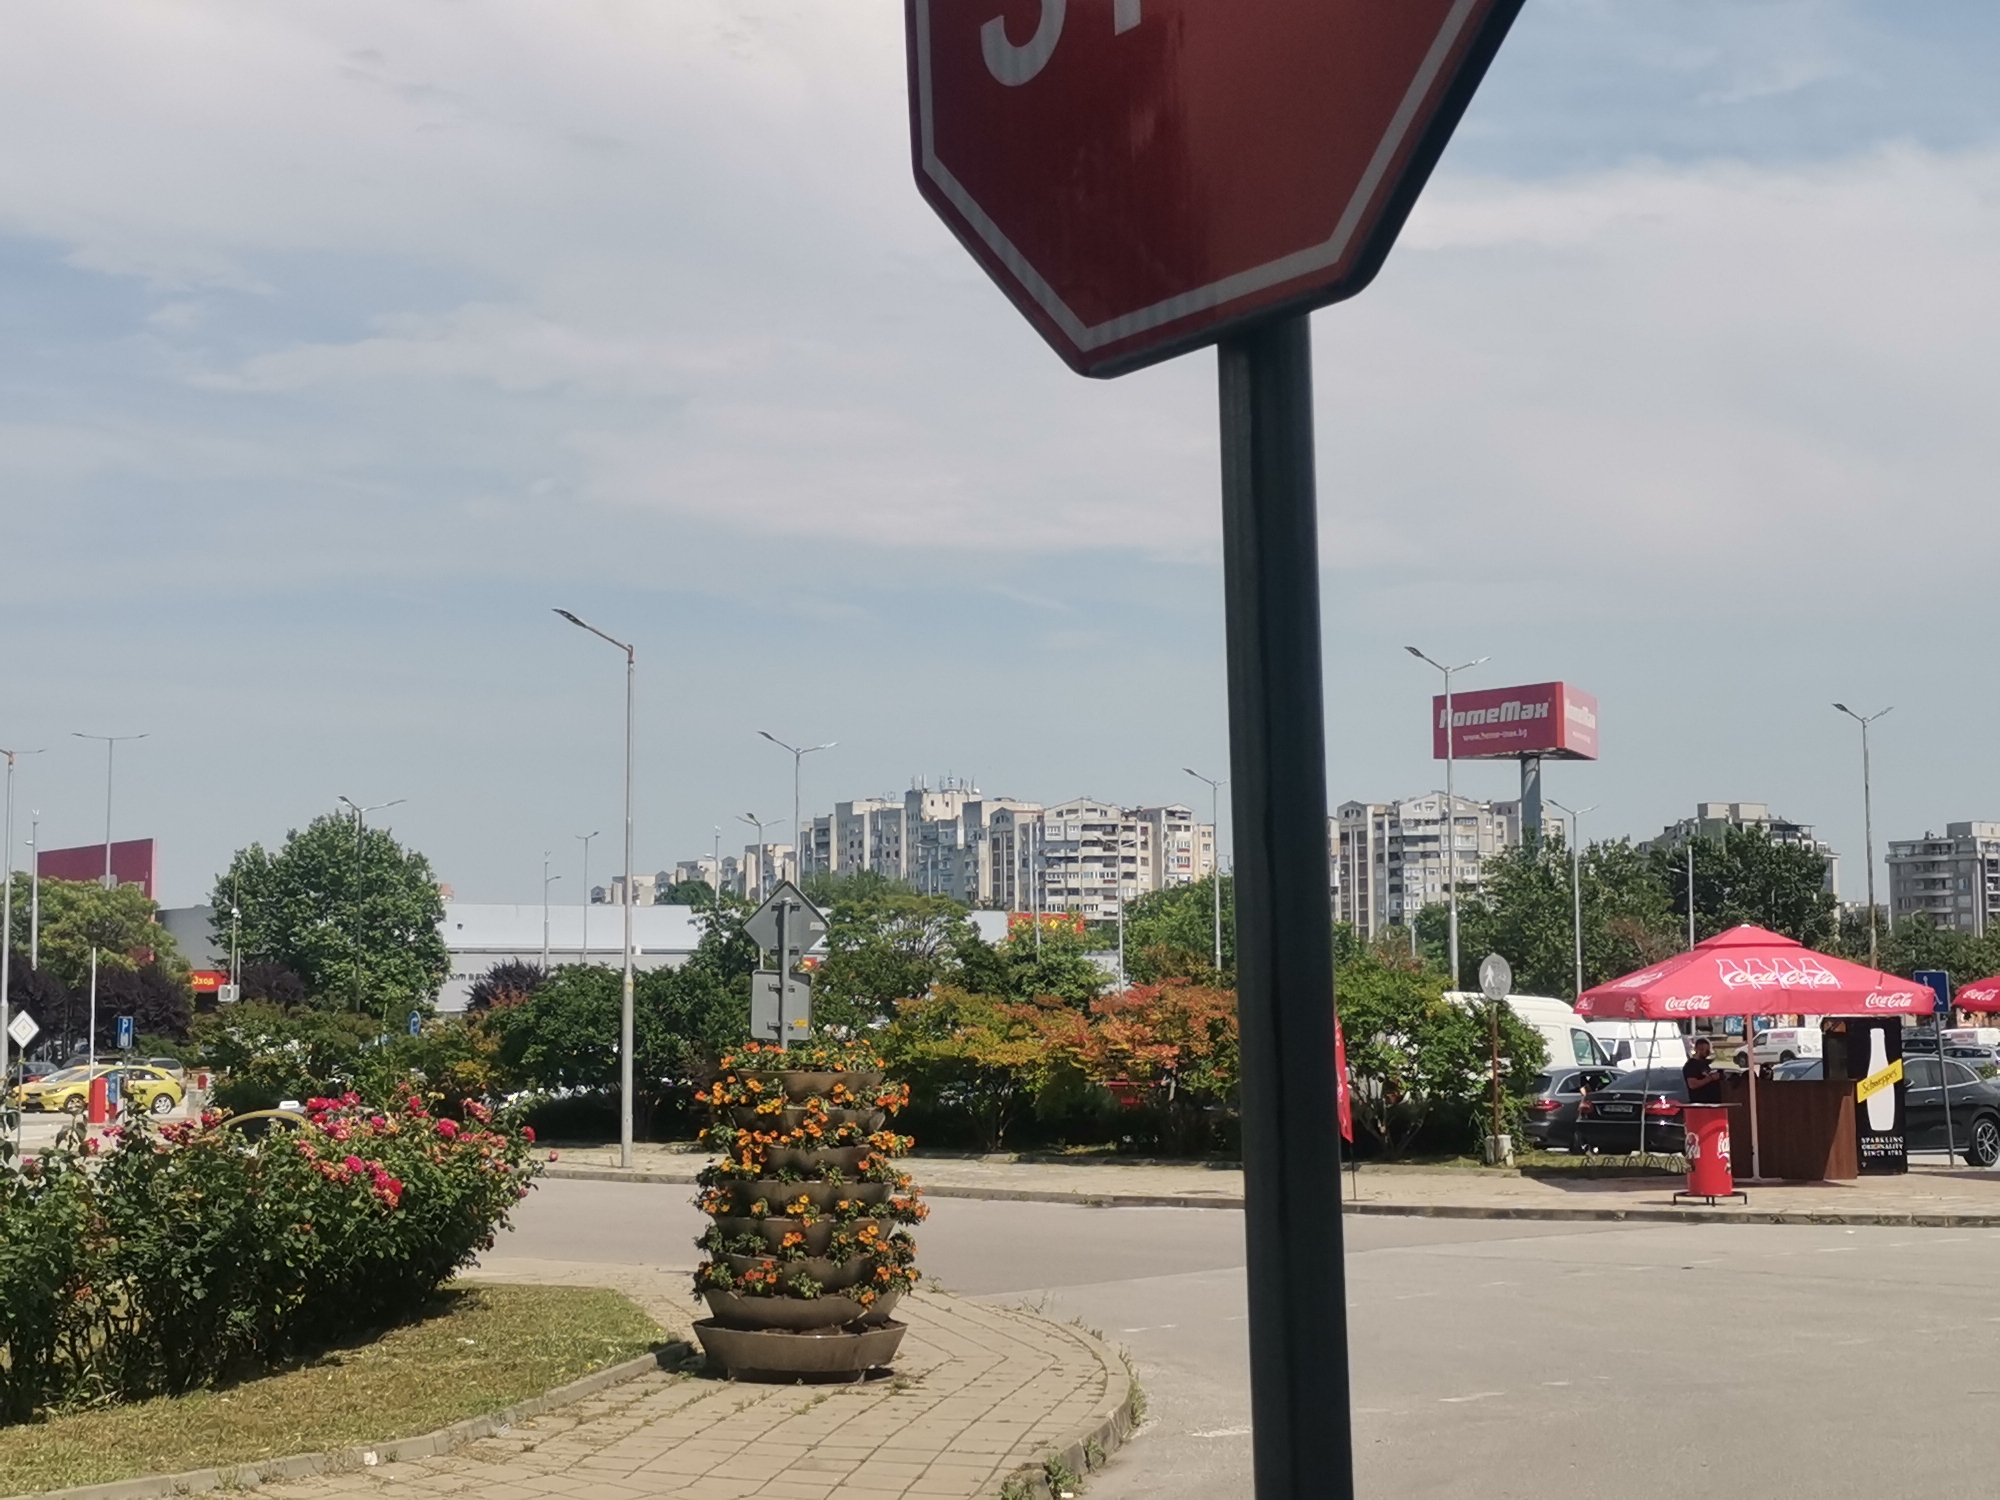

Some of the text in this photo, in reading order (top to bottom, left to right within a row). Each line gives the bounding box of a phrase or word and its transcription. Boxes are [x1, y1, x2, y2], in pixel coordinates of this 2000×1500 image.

[1439, 701, 1549, 728] HomeMax
[1665, 995, 1712, 1011] Coca-Cola
[1865, 992, 1914, 1008] Coca-Cola
[1861, 1136, 1903, 1144] SPARKLING
